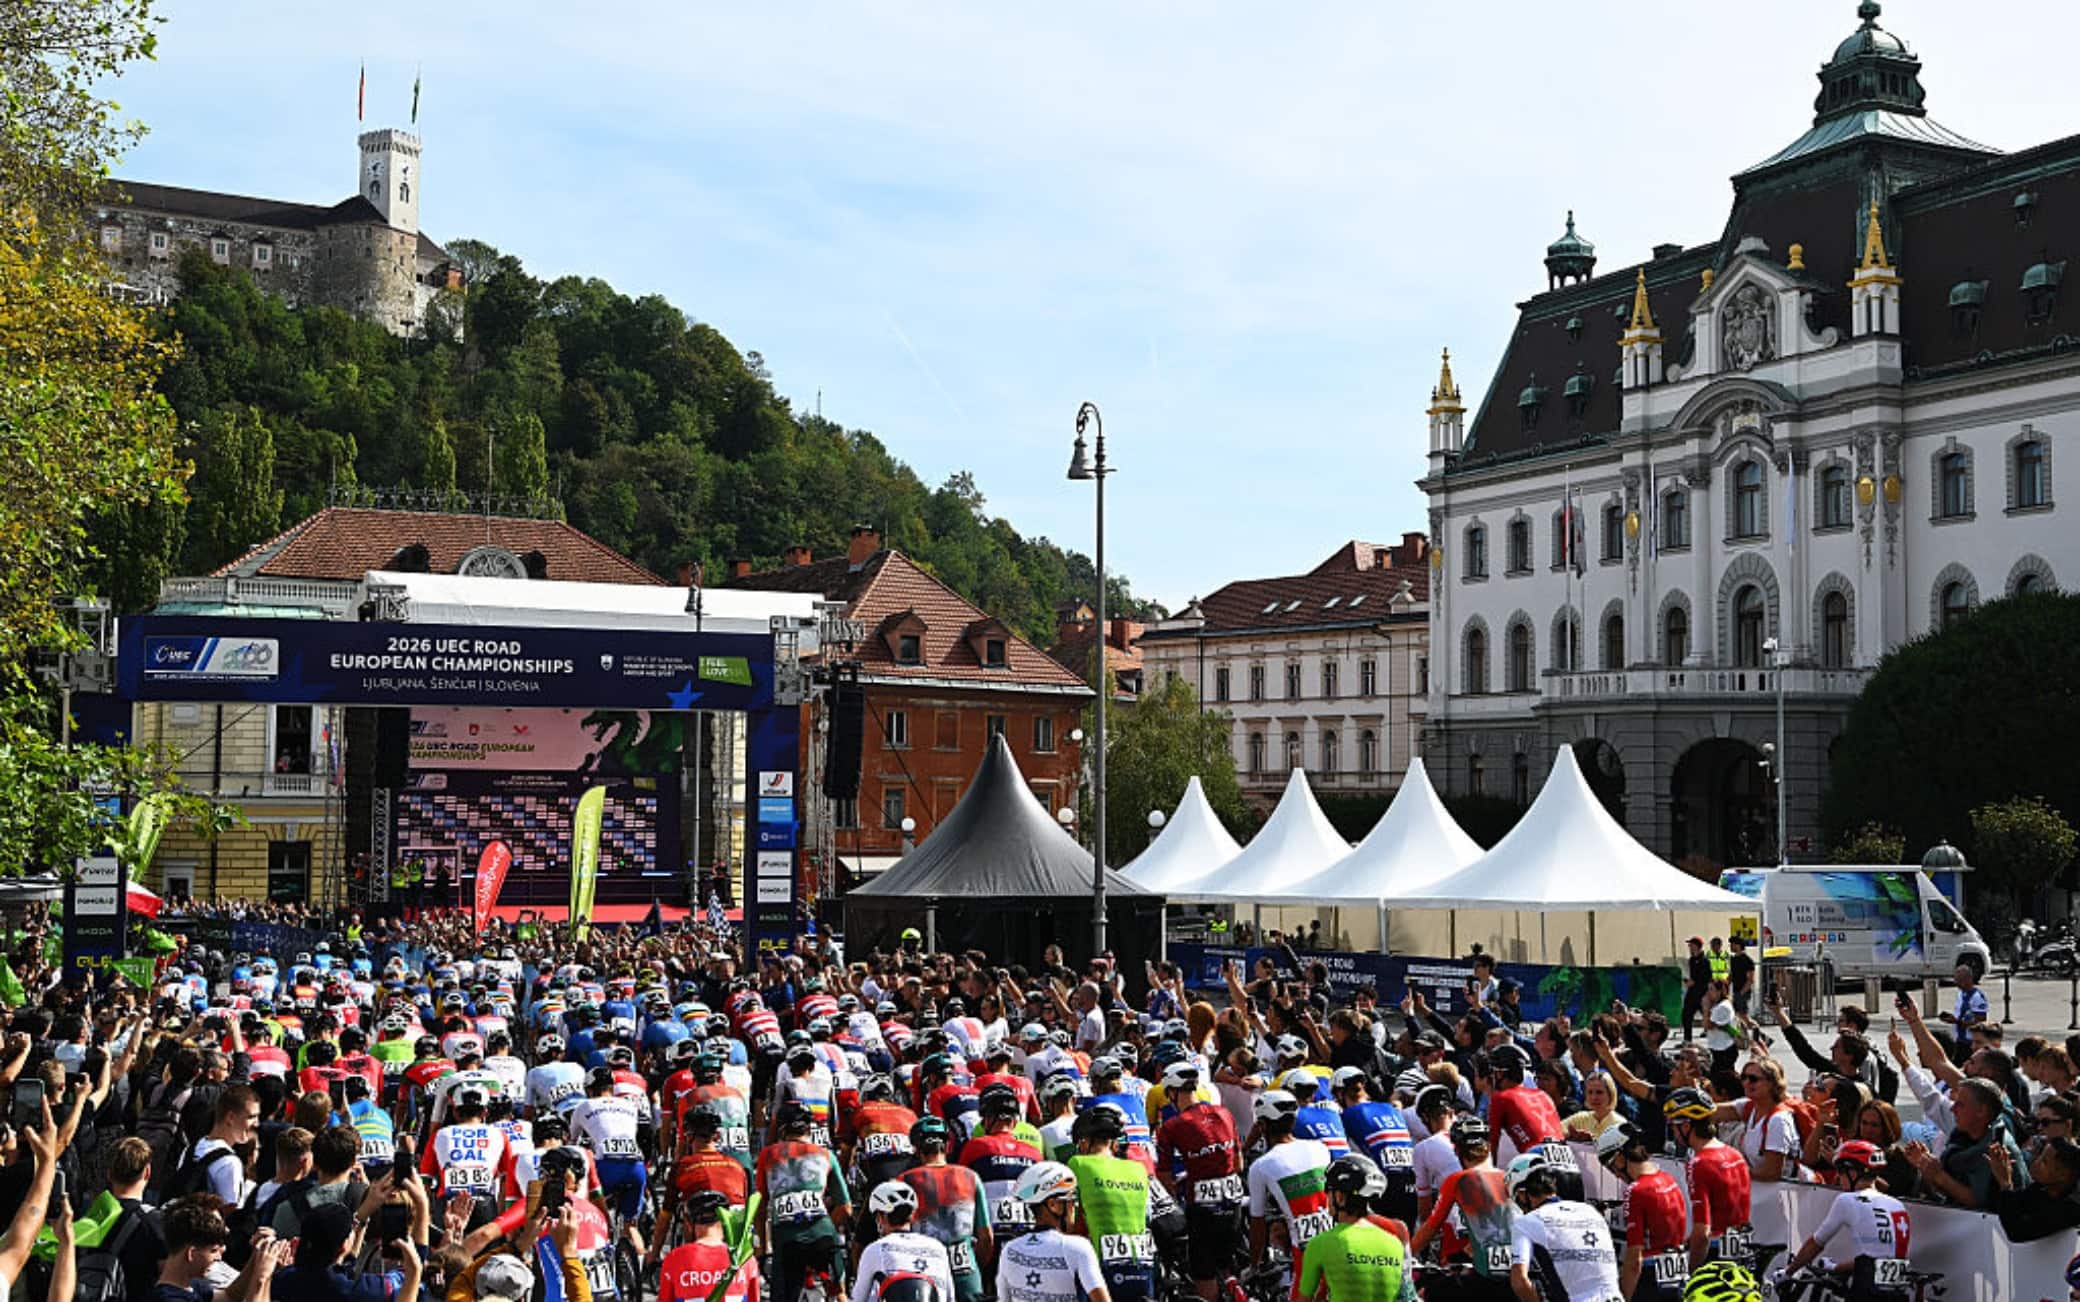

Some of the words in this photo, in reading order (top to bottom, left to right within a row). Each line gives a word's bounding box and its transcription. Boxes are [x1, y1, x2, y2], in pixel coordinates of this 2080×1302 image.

[387, 637, 432, 653] 2026
[435, 639, 470, 653] UEC
[474, 640, 521, 655] ROAD
[330, 653, 428, 669] EUROPEAN
[431, 657, 574, 673] CHAMPIONSHIPS
[485, 680, 541, 692] SLOVENIA
[451, 1128, 488, 1138] POR
[449, 1149, 487, 1161] GAL
[1093, 1177, 1145, 1192] SLOVENIA
[1872, 1207, 1893, 1244] SUI
[1105, 1234, 1128, 1256] 96
[1491, 1247, 1510, 1266] 64
